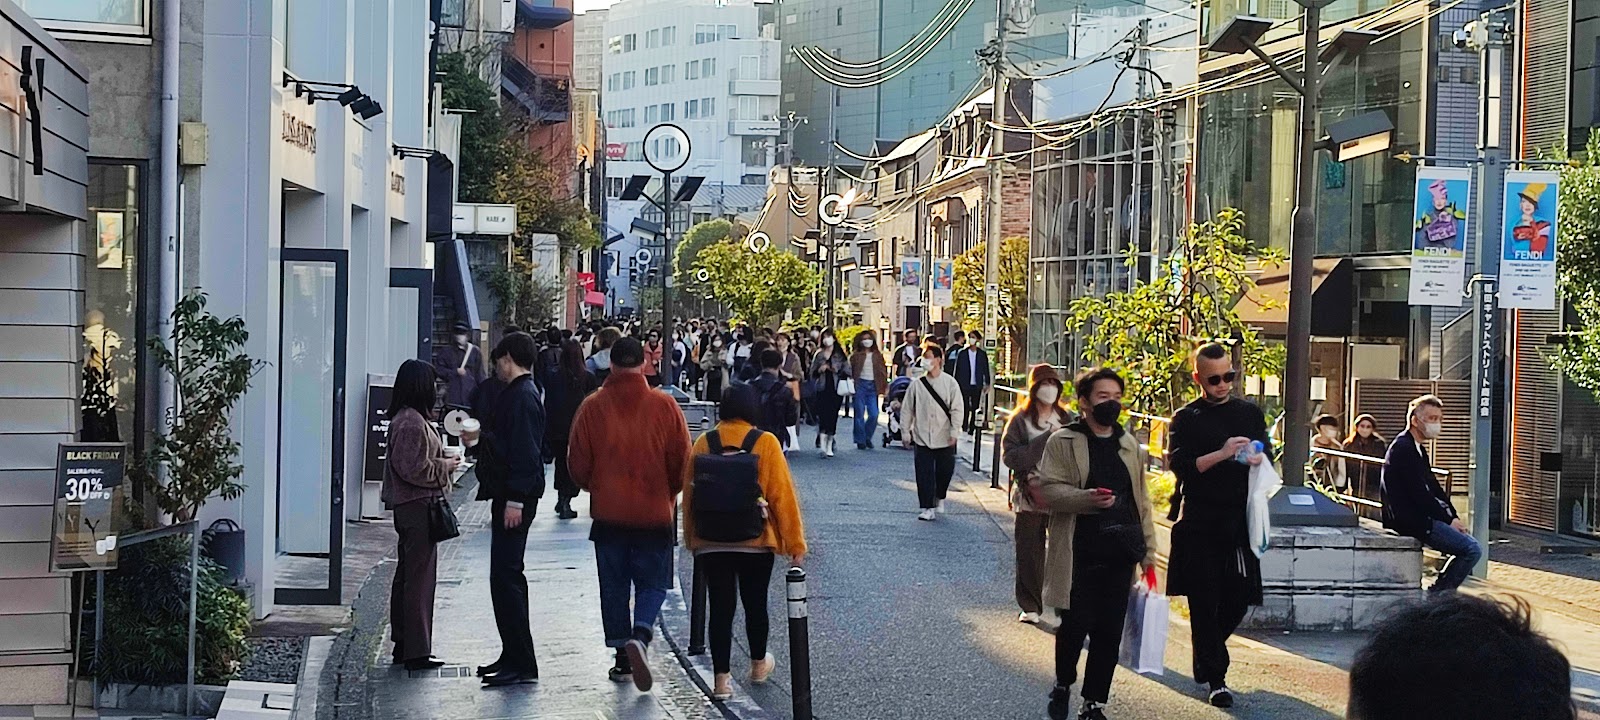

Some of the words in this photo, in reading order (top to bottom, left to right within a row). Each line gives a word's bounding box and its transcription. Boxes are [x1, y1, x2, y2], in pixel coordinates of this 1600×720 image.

[1424, 247, 1451, 256] FENDI
[1515, 250, 1542, 260] FENDI
[66, 452, 91, 460] BLACK
[92, 452, 120, 460] FRIDAY
[89, 491, 103, 499] OFF
